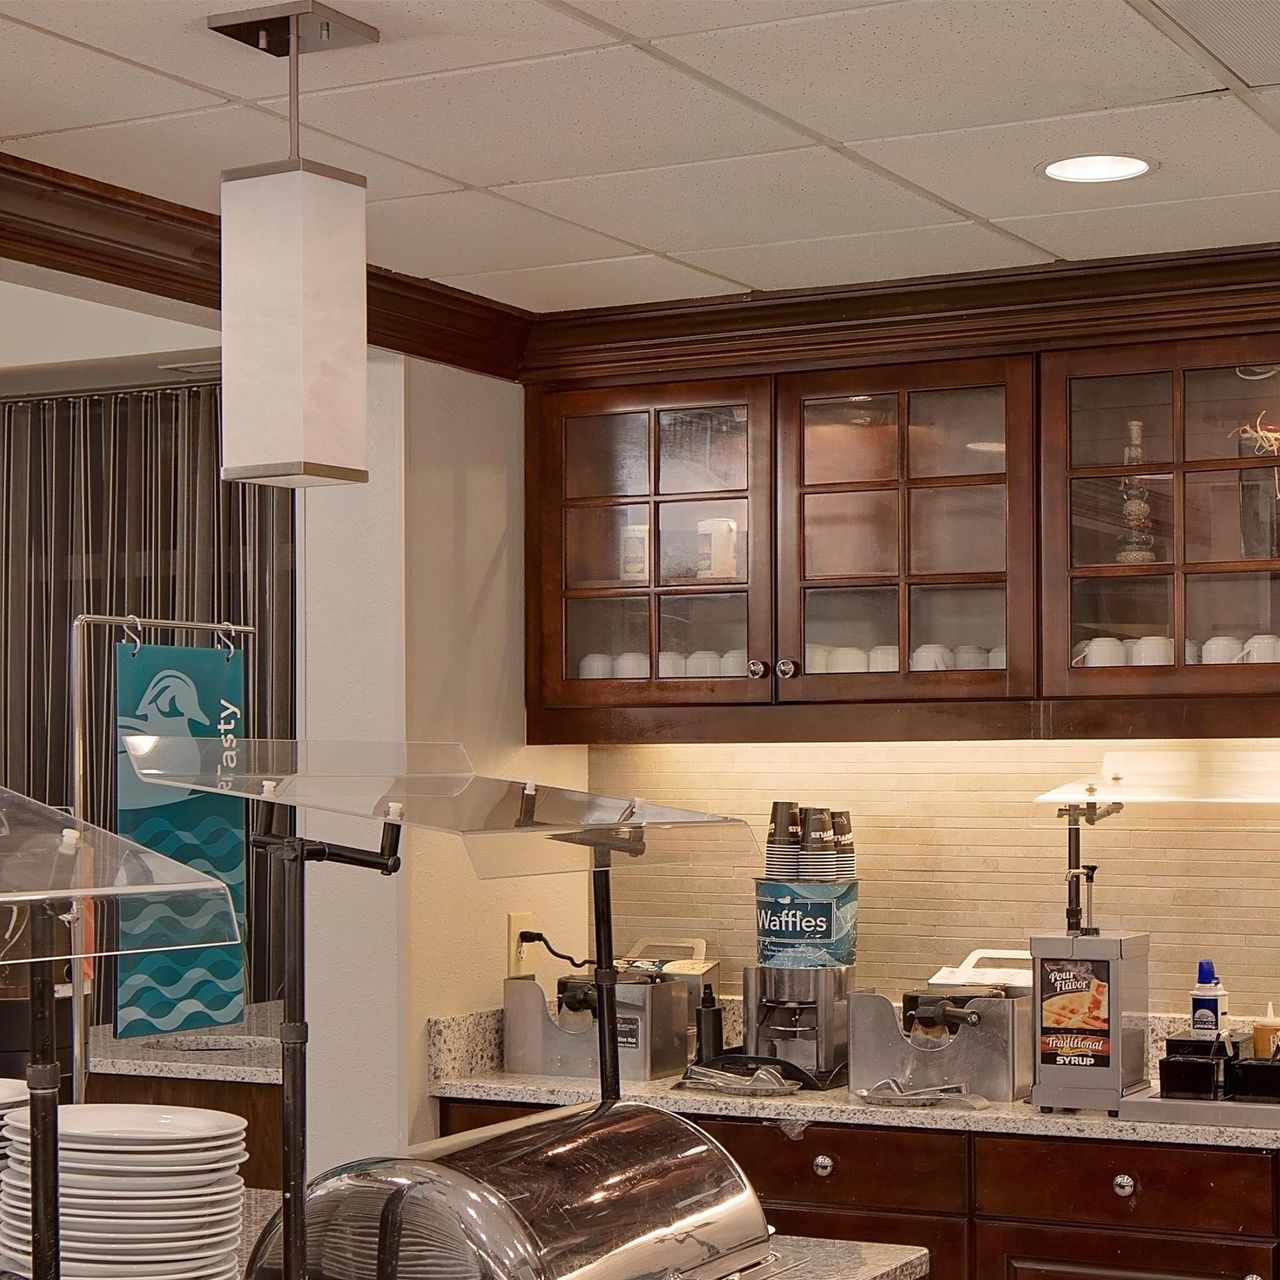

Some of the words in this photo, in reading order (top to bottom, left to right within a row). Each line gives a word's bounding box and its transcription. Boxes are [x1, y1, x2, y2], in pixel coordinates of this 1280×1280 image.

[757, 909, 827, 932] Waffles
[1049, 971, 1076, 983] Pour
[1054, 980, 1089, 992] Flavor
[1046, 1037, 1104, 1050] Traditional
[1056, 1056, 1095, 1066] SYRUP
